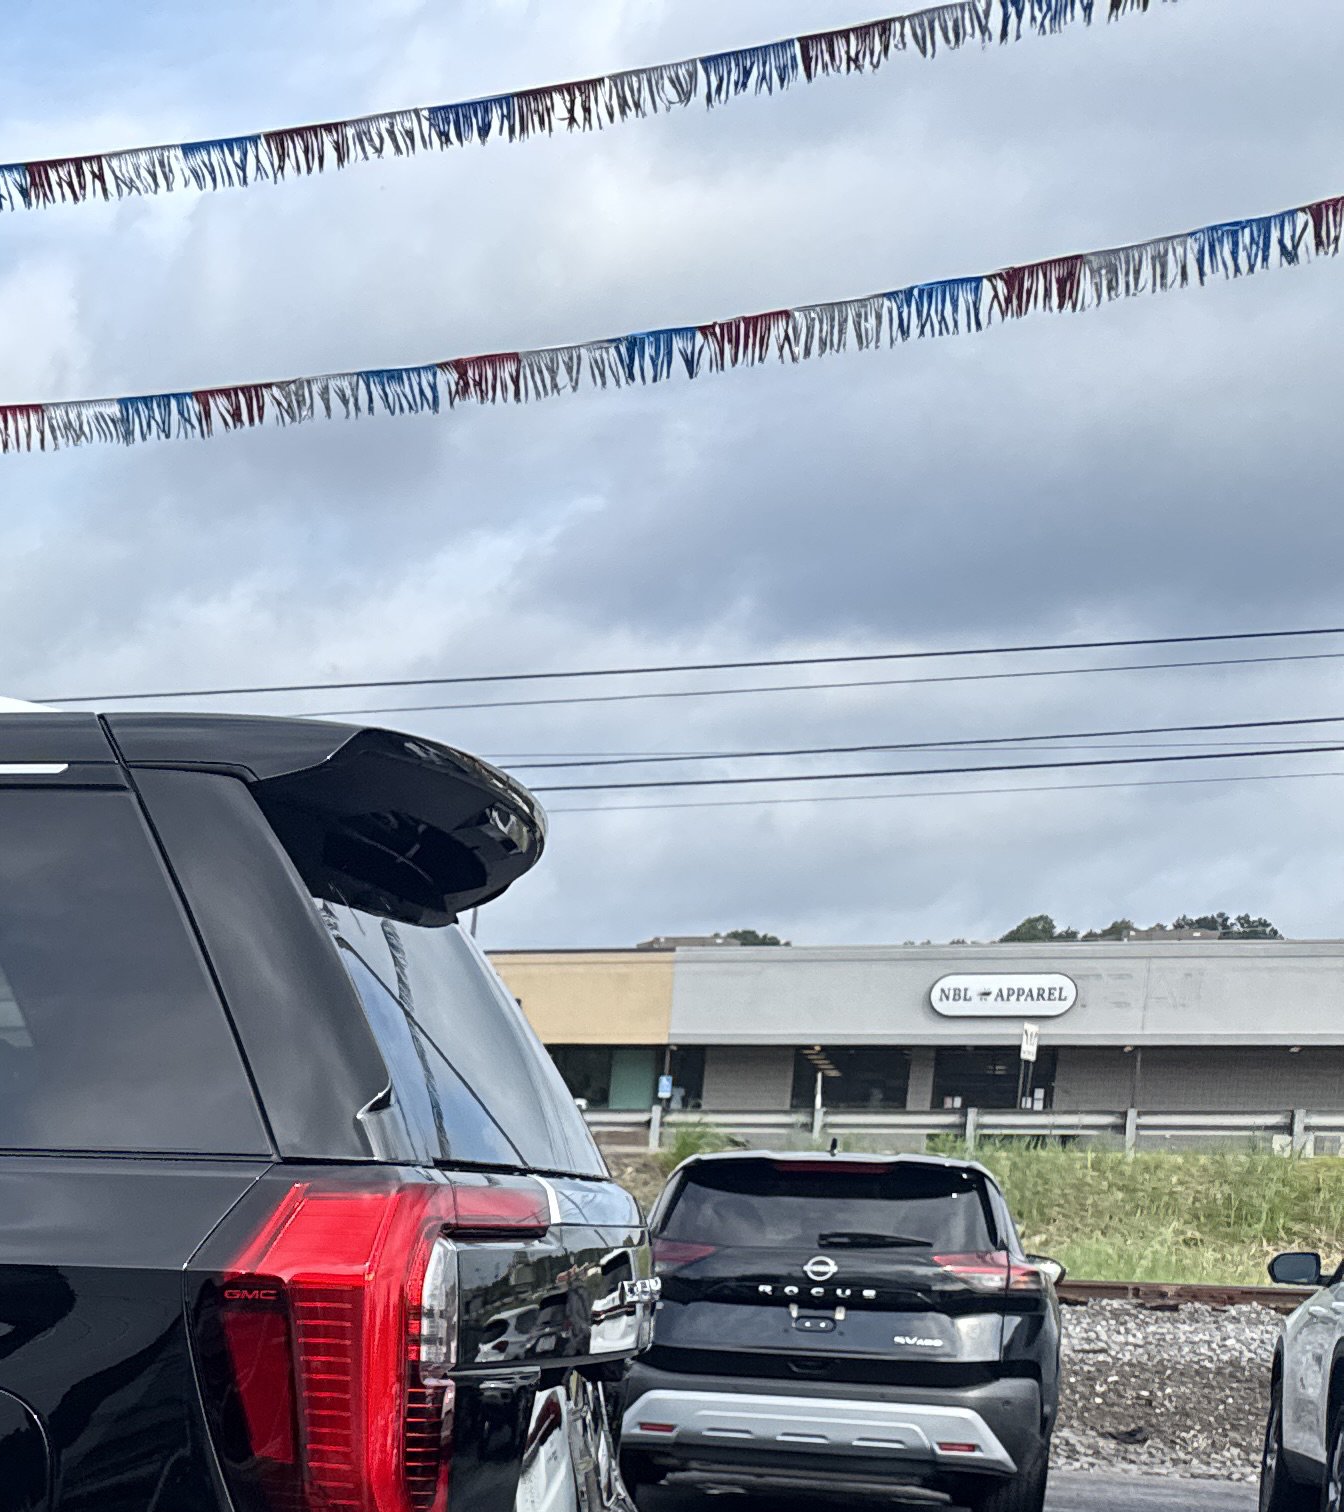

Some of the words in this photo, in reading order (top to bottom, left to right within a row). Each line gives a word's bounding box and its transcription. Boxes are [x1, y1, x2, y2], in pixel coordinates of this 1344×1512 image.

[939, 987, 972, 1002] NBL
[994, 986, 1068, 1002] APPAREL
[224, 1289, 277, 1300] GMC
[758, 1284, 877, 1299] ROGUE
